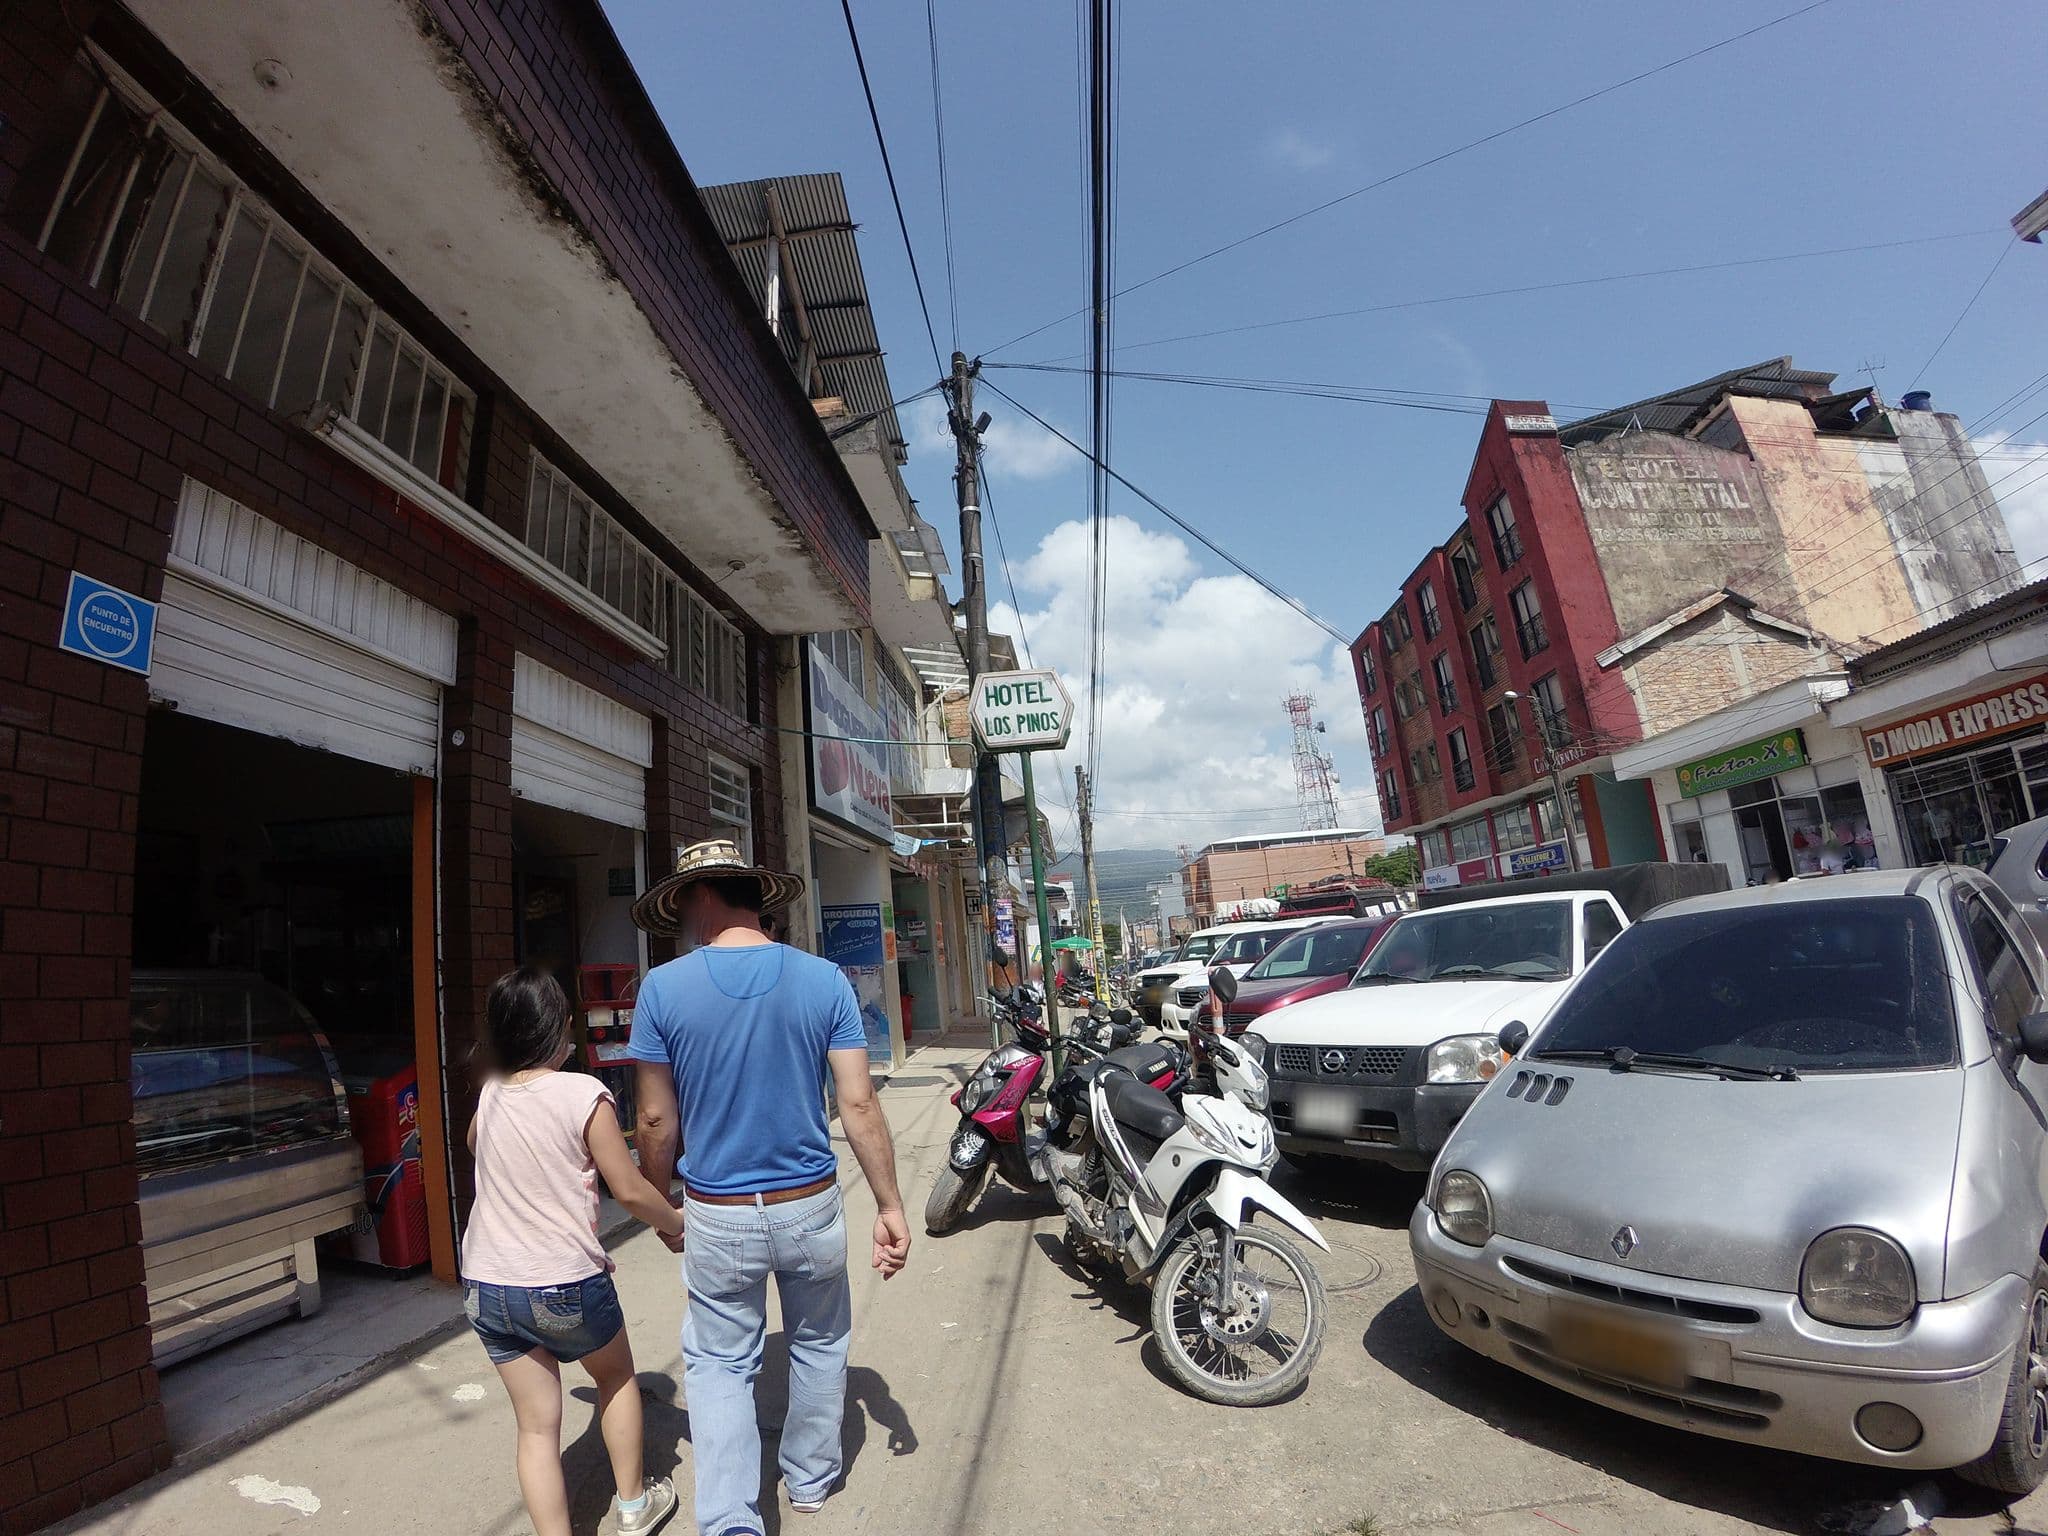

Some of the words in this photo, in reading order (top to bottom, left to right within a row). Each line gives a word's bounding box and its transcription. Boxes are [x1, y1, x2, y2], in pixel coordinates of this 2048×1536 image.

[91, 605, 119, 621] PUNTO
[119, 615, 131, 626] DE
[83, 617, 133, 640] ENCUENTRO
[984, 681, 1053, 707] HOTEL
[984, 716, 1011, 736] LOS
[1016, 711, 1060, 733] PINOS
[1887, 716, 1948, 756] MODA
[1948, 683, 2048, 740] EXPRESS
[1694, 756, 1759, 782] Factor
[1762, 739, 1779, 761] X
[823, 908, 879, 919] DROGUERIA
